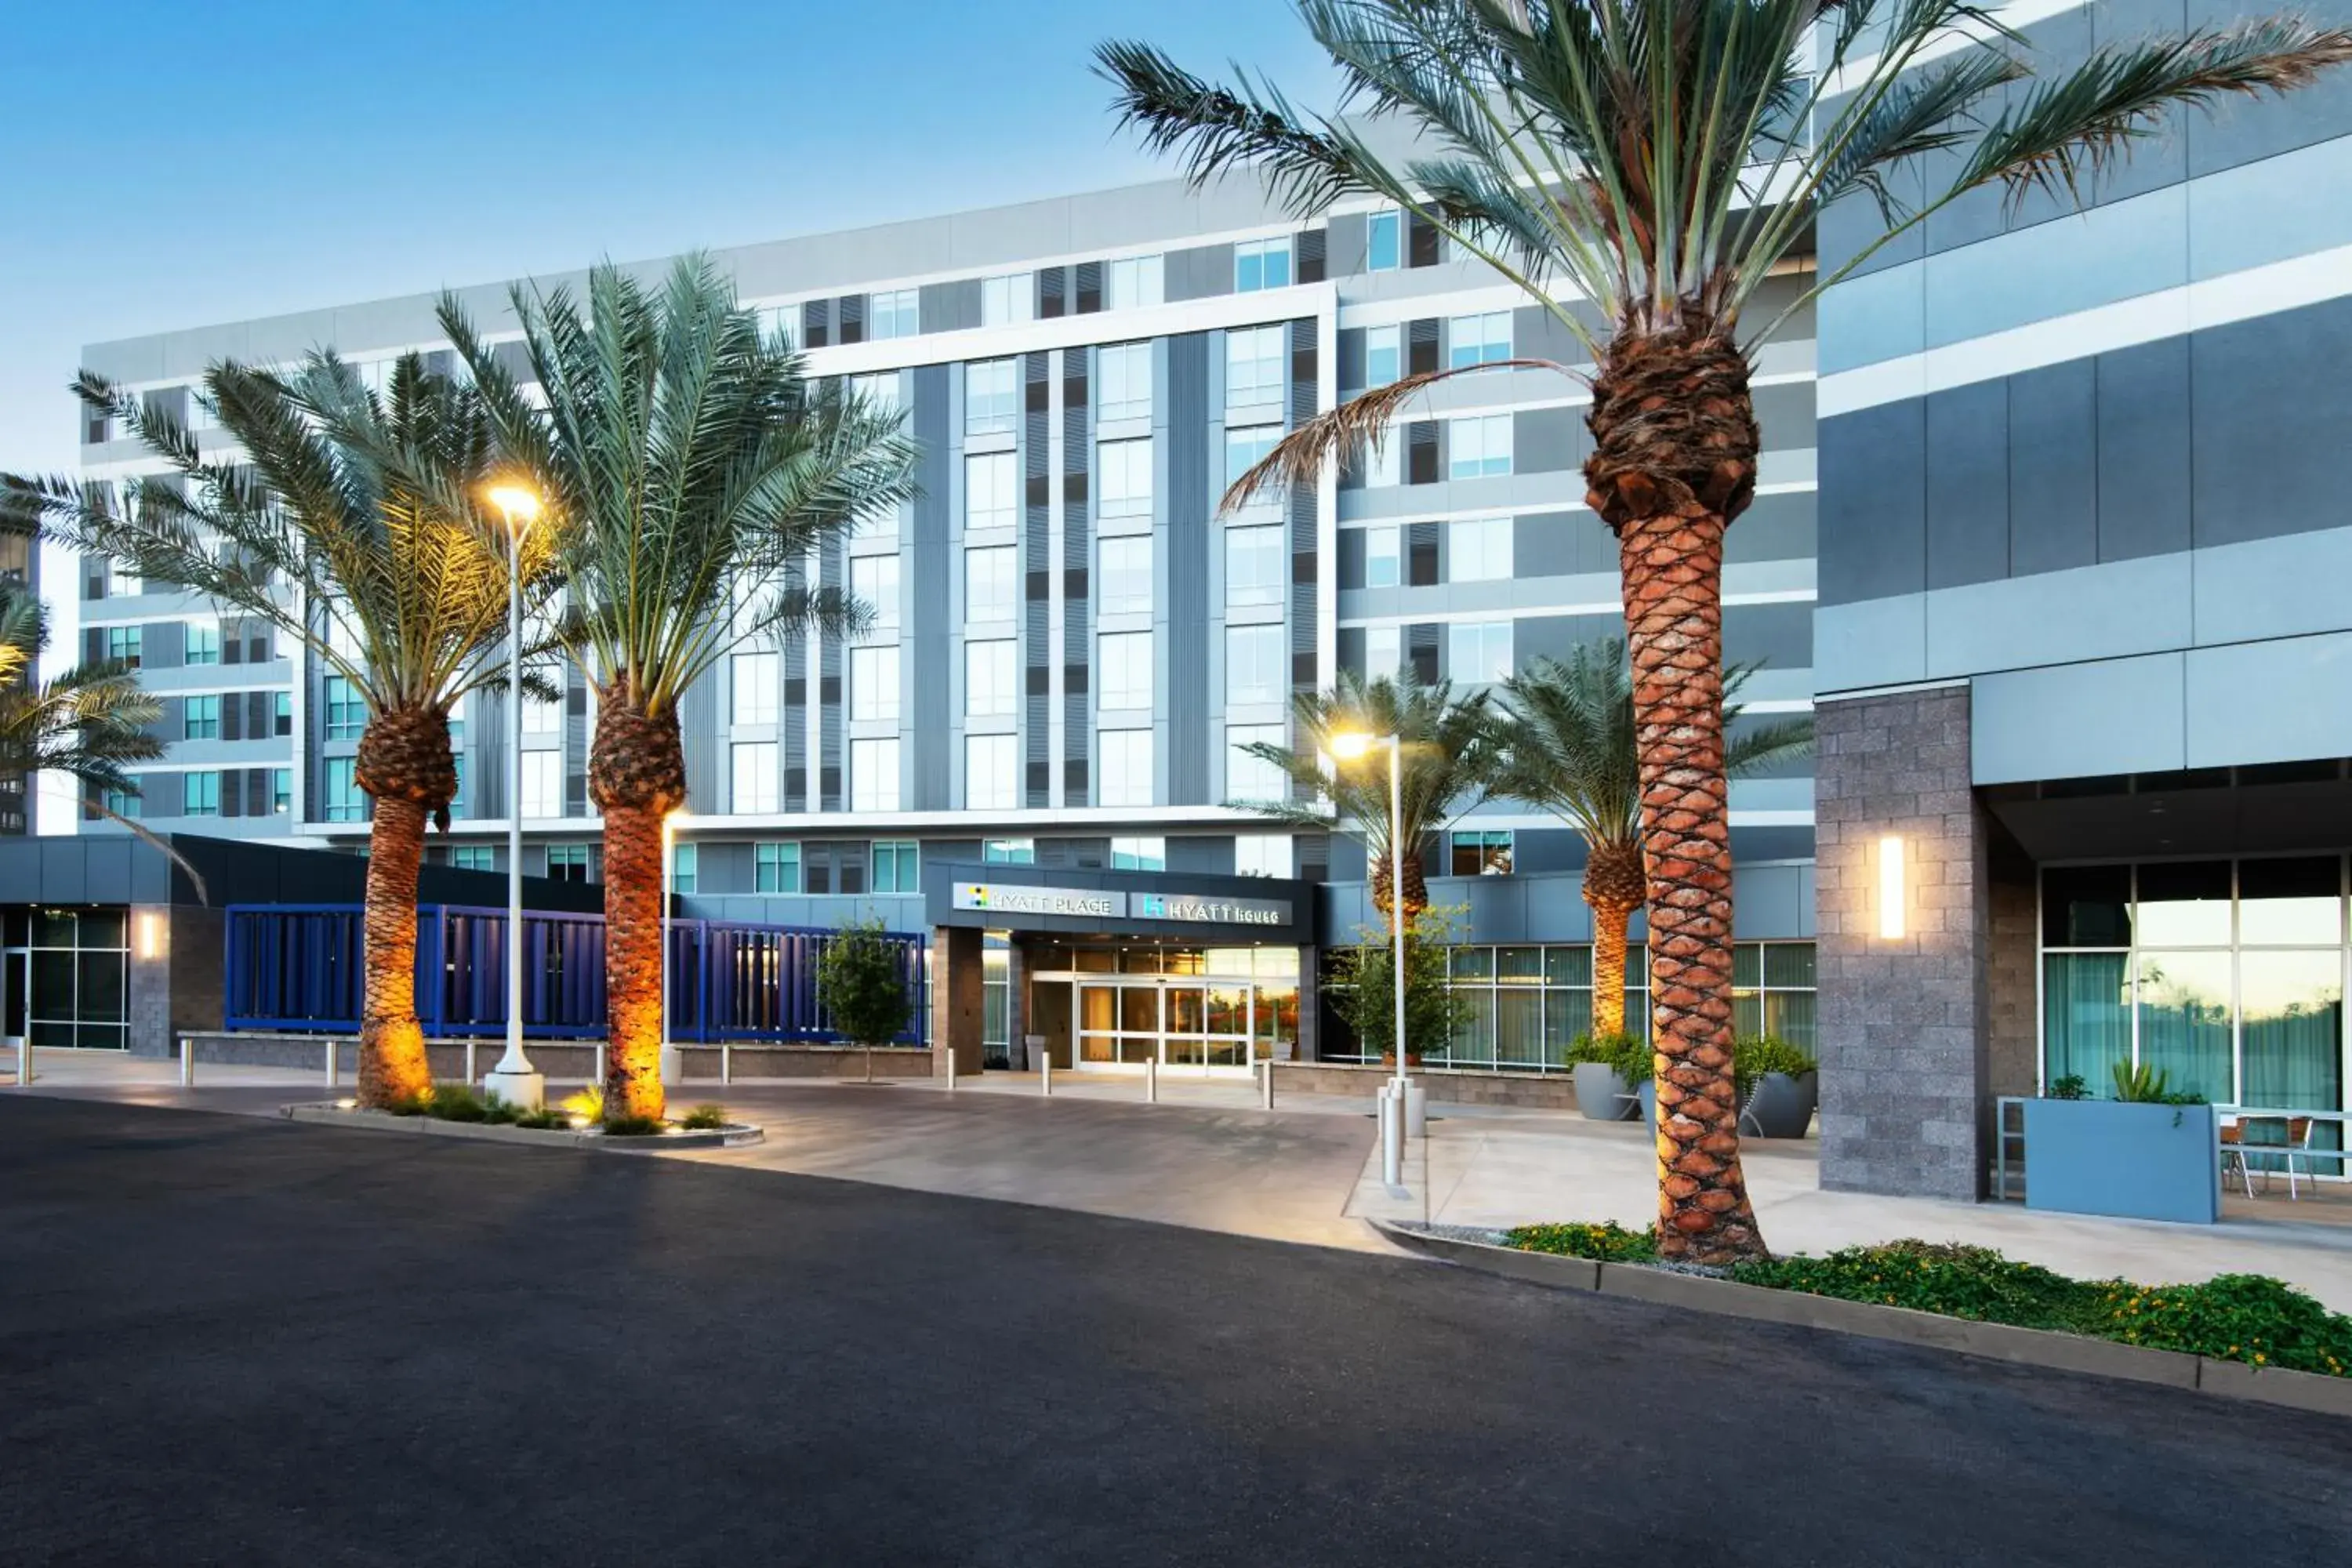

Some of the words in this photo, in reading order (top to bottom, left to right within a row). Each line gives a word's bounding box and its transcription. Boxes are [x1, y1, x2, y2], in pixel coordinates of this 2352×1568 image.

[993, 890, 1047, 909] HYATT
[1054, 896, 1111, 914] PLACE
[1169, 902, 1232, 921] HYATT
